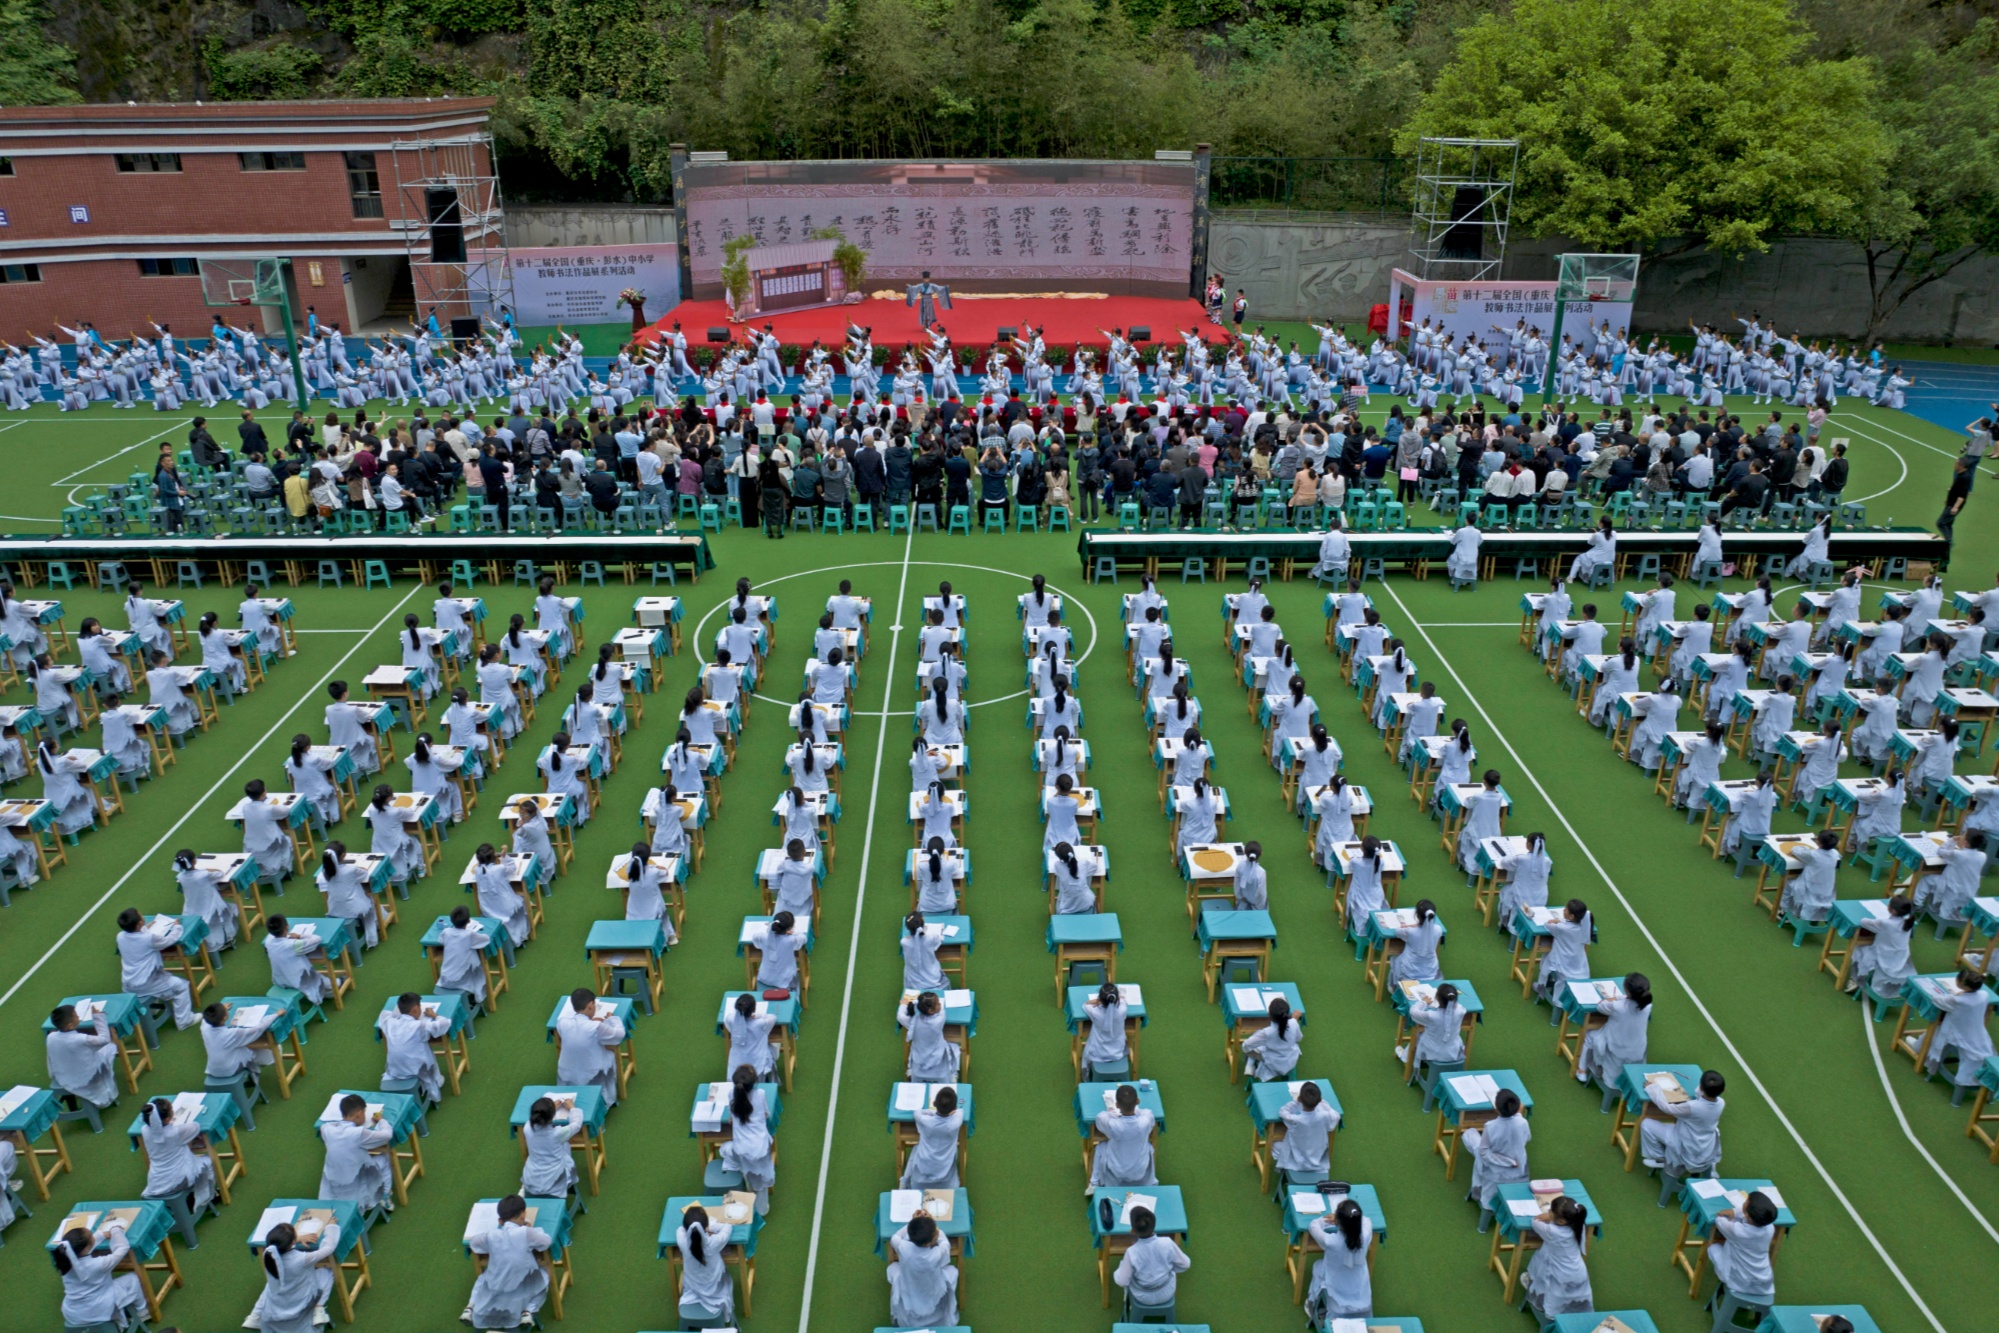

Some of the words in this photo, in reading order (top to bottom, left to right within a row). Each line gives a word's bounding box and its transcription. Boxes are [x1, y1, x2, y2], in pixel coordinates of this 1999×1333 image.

[538, 265, 636, 279] 教师书法作品展系列活动
